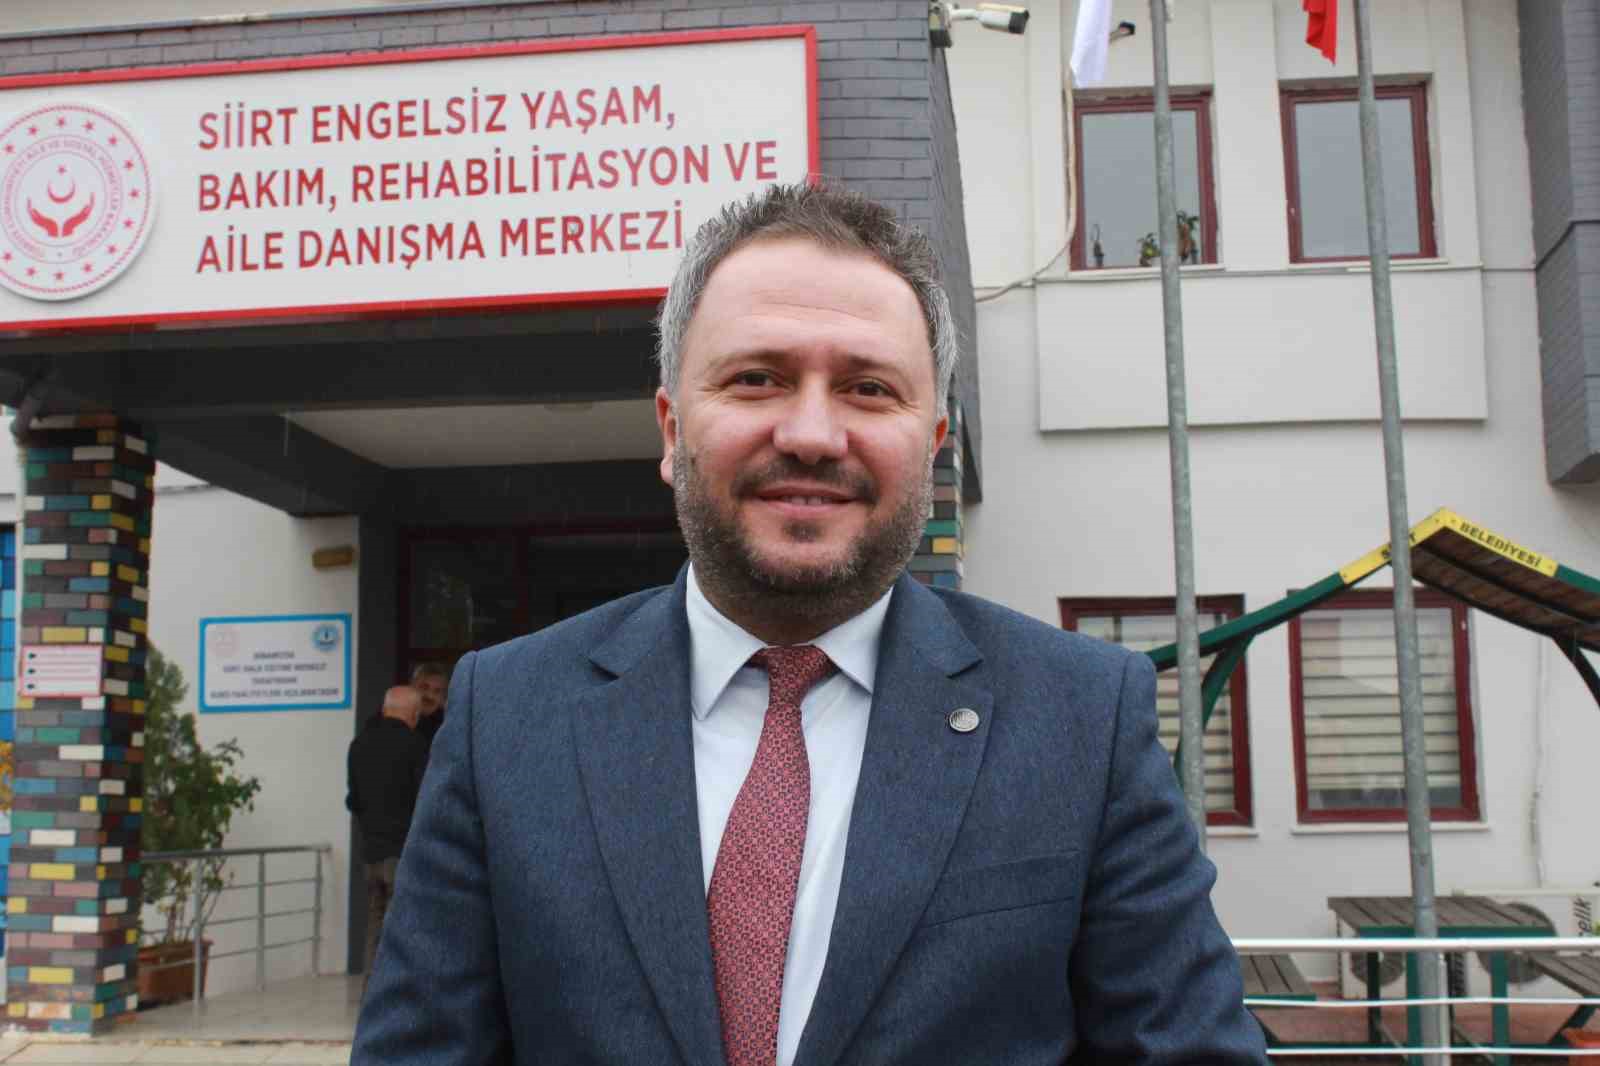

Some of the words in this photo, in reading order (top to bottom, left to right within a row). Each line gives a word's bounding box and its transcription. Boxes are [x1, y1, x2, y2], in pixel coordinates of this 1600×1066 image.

[198, 107, 298, 150] SİİRT
[312, 87, 507, 144] ENGELSİZ
[522, 84, 676, 135] YAŞAM,
[198, 168, 337, 212] BAKIM,
[351, 145, 710, 203] REHABİLİTASYON
[725, 141, 778, 182] VE
[197, 231, 285, 273] AİLE
[298, 222, 486, 270] DANIŞMA
[500, 200, 683, 257] MERKEZİ
[1459, 521, 1541, 567] BELEDİYESİ
